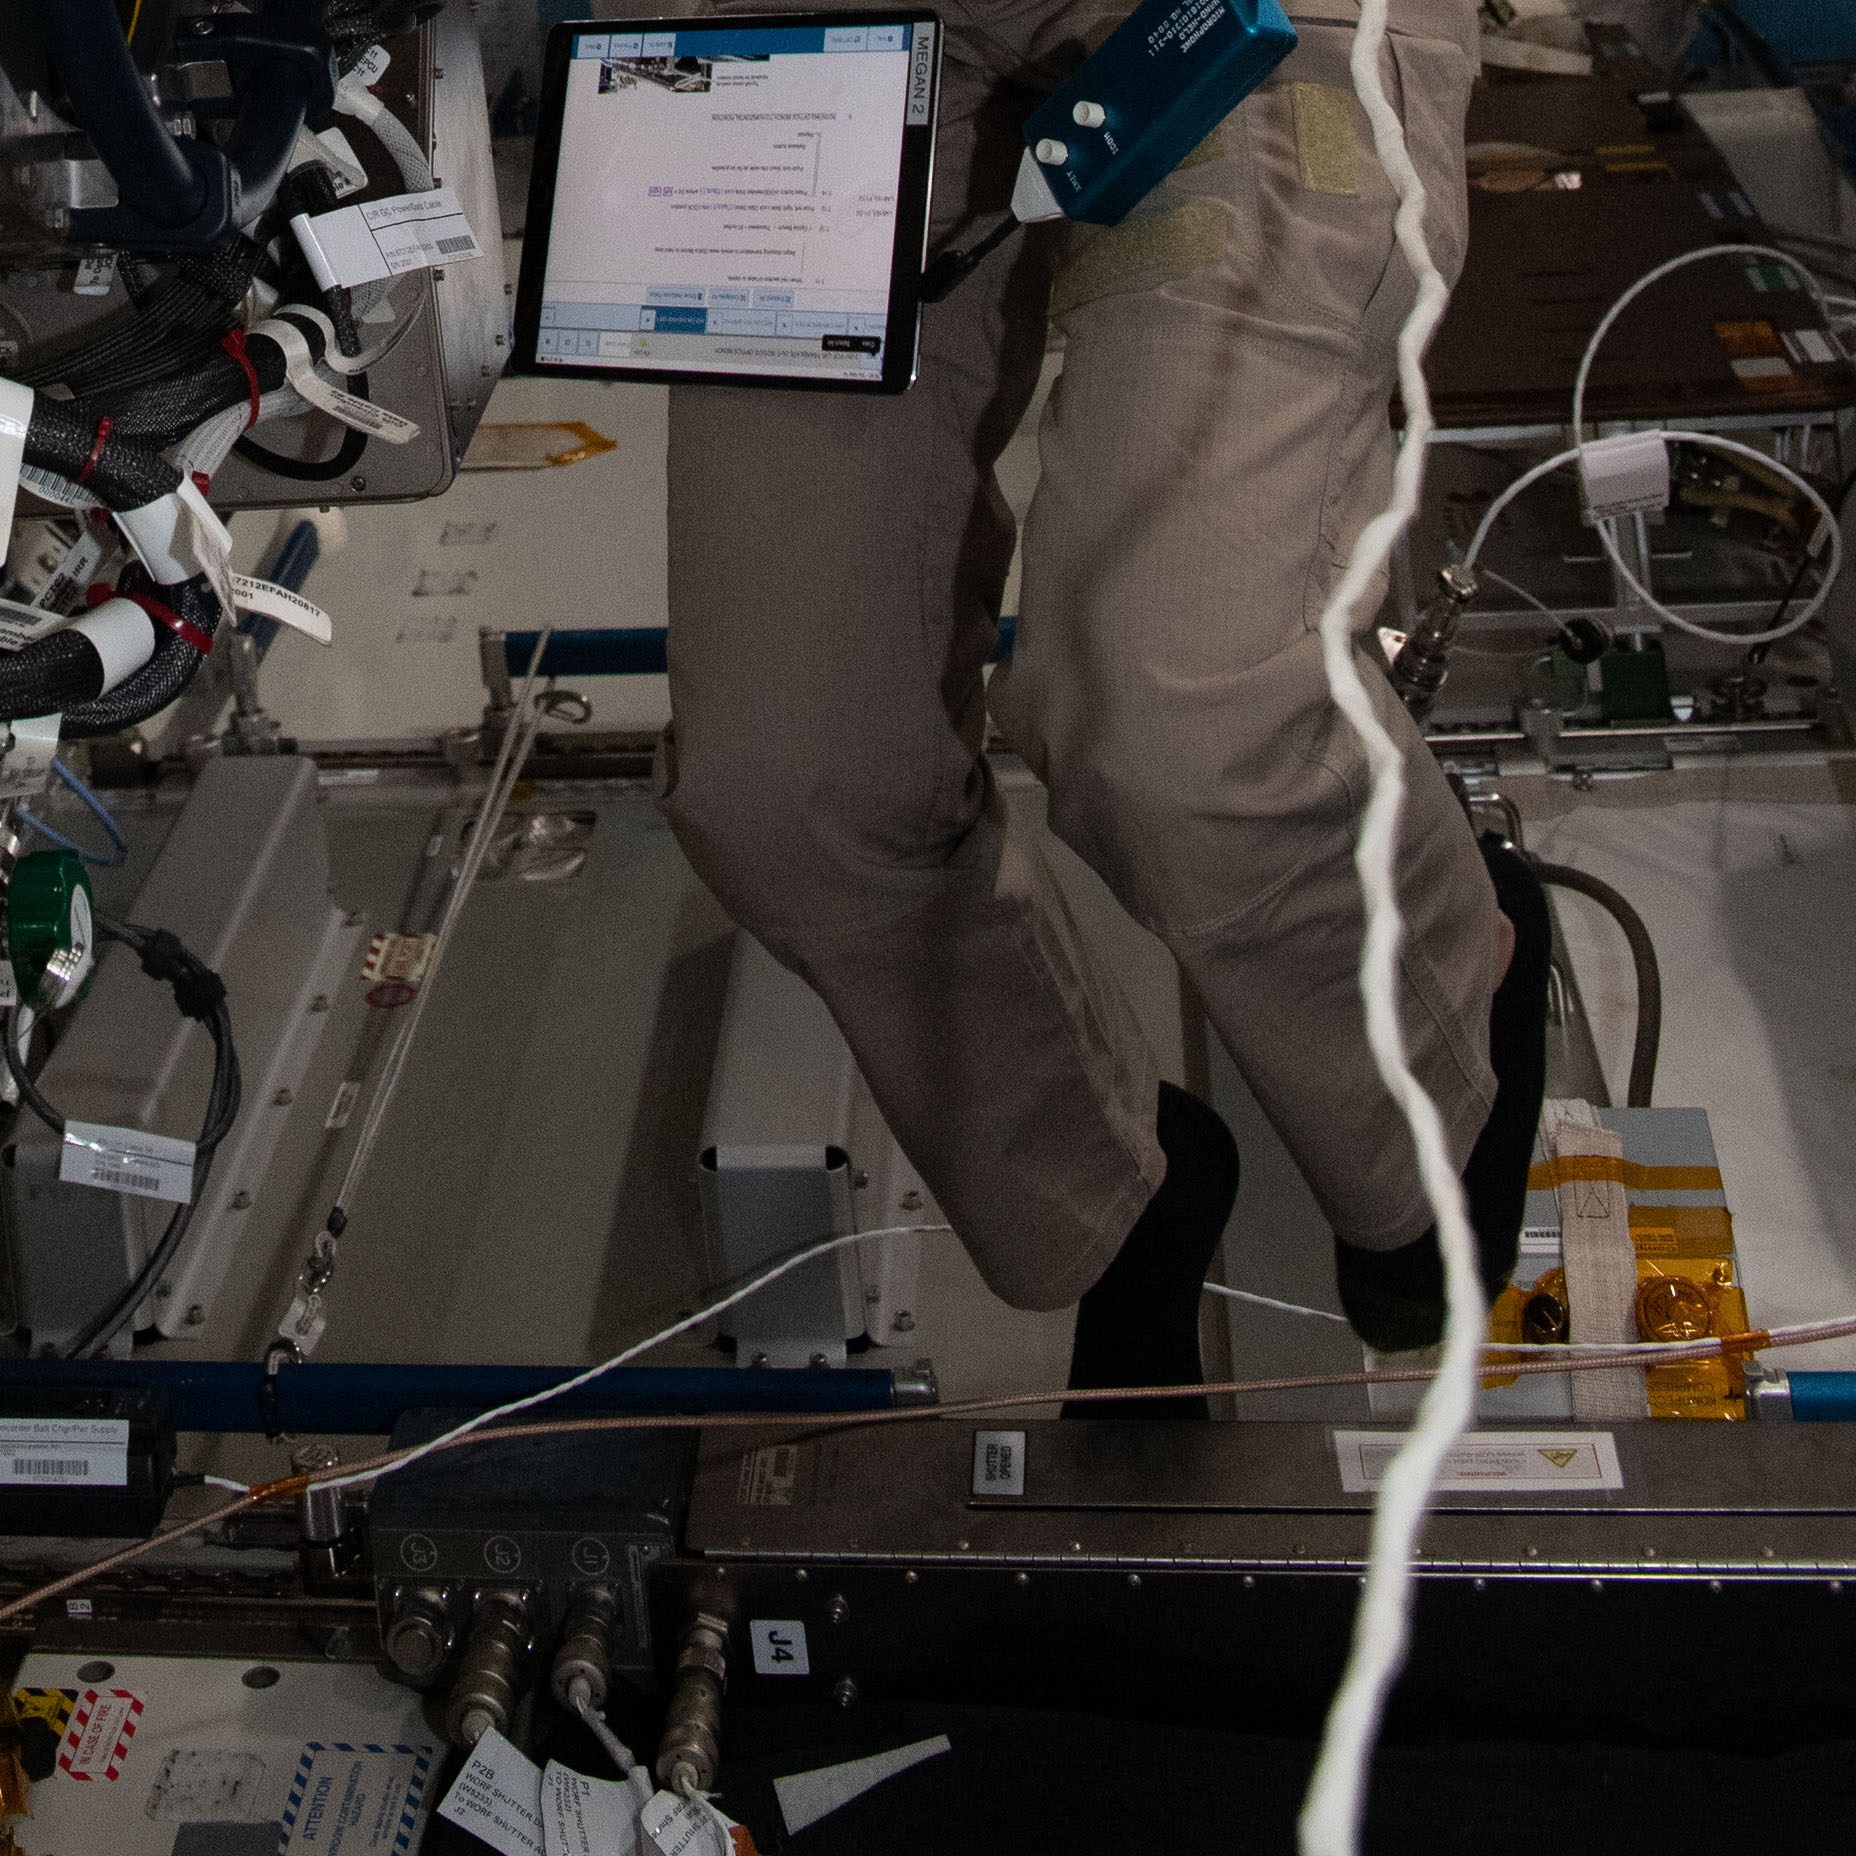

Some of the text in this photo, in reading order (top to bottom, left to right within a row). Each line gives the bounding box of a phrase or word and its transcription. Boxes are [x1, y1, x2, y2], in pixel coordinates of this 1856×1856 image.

[1176, 4, 1227, 54] MICROPHONE
[911, 35, 929, 114] MEGAN 2
[90, 1424, 119, 1436] Supply
[983, 1443, 998, 1481] SHUTTER
[998, 1444, 1014, 1480] OPENED
[493, 1542, 512, 1567] J2
[767, 1630, 794, 1664] J4
[90, 1721, 105, 1735] OF
[93, 1700, 113, 1724] FIRE
[78, 1753, 93, 1767] IN
[82, 1732, 101, 1756] CASE
[469, 1758, 498, 1782] P2B
[462, 1771, 537, 1822] WORF SHUTTER
[552, 1786, 568, 1818] WORF
[579, 1779, 590, 1797] P1
[301, 1773, 334, 1842] ATTENTION
[348, 1791, 367, 1828] HAZARD
[462, 1797, 493, 1821] WORF
[488, 1814, 537, 1850] SHUTTER
[568, 1776, 590, 1855] WORF SHUTTER
